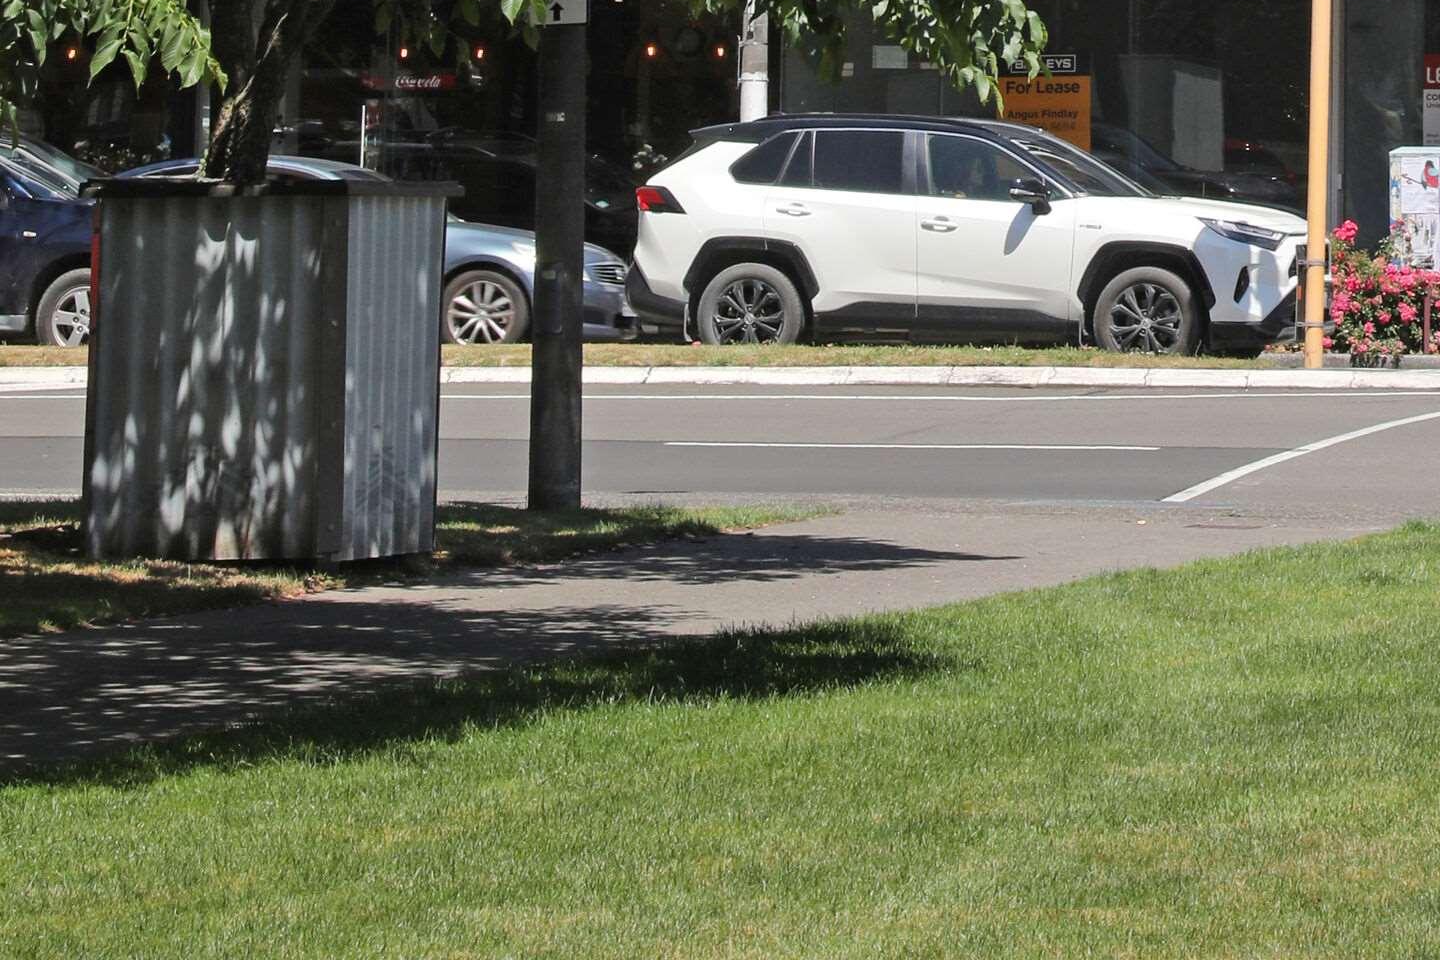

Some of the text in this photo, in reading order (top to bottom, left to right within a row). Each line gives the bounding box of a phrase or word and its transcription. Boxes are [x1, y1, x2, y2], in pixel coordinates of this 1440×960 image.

[1015, 59, 1072, 69] BEYS
[1006, 80, 1081, 94] For Lease
